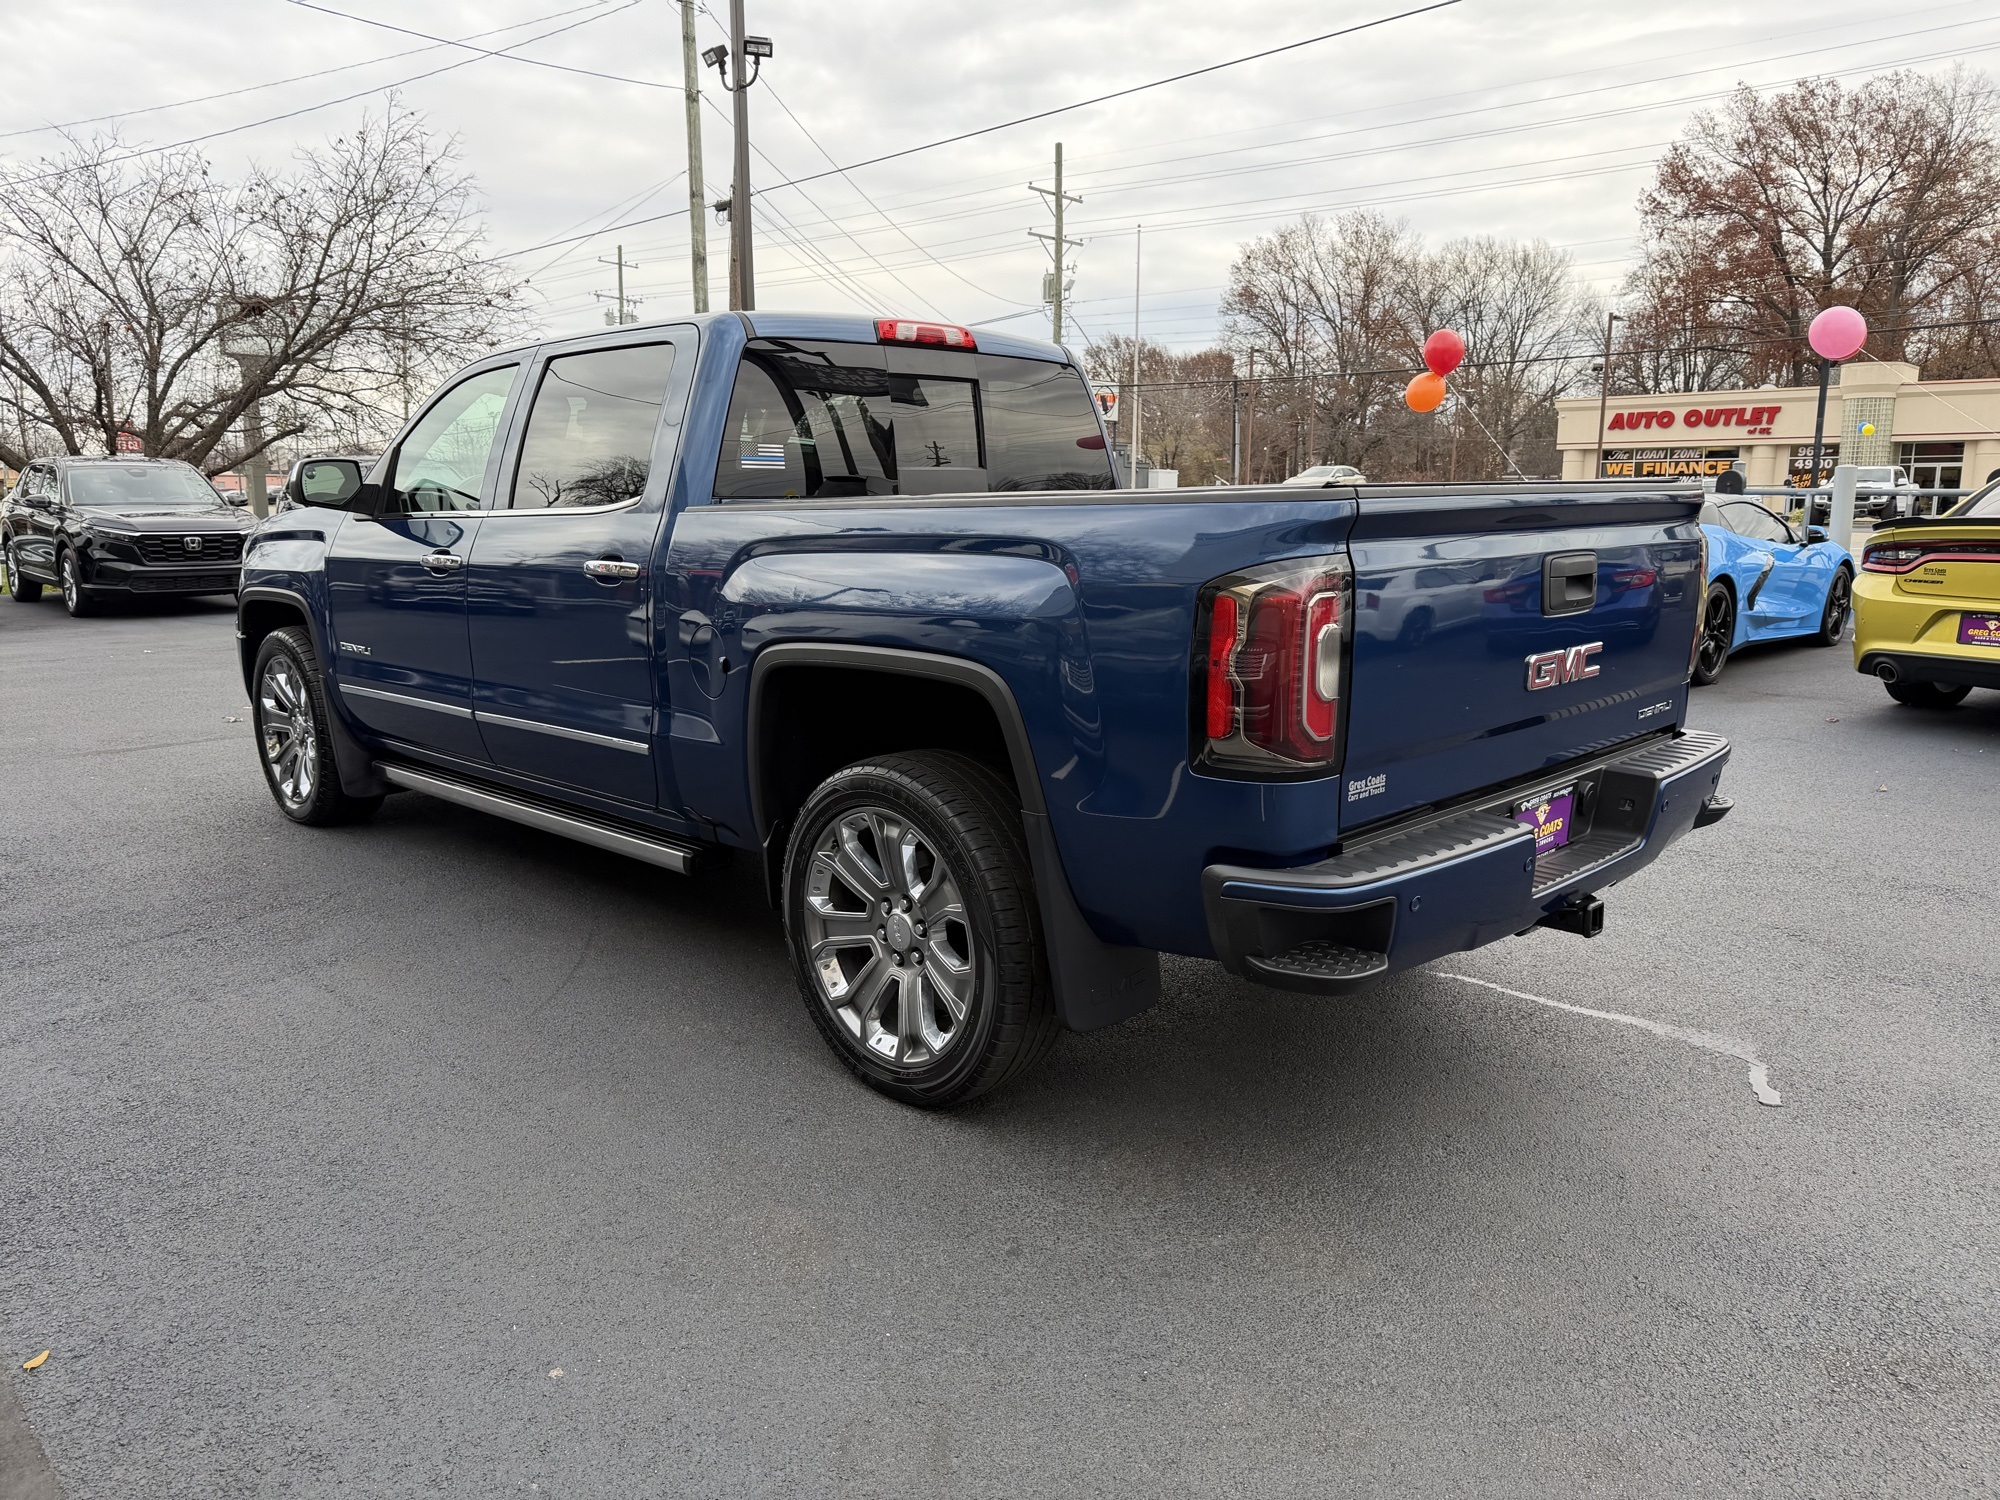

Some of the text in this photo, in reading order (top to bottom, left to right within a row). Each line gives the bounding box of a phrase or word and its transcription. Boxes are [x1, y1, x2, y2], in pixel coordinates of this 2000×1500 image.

[1607, 406, 1782, 430] AUTO OUTLET
[1607, 448, 1701, 460] The LOAN ZONE
[1606, 461, 1731, 475] WE FINANCE
[1967, 628, 1990, 637] GREG
[339, 641, 372, 656] DENALI
[1524, 641, 1604, 692] GMC
[1637, 700, 1673, 720] DENALI
[1348, 773, 1387, 792] Greg Coats
[1347, 794, 1359, 802] Cars
[1359, 790, 1370, 799] and
[1540, 818, 1563, 837] COATS
